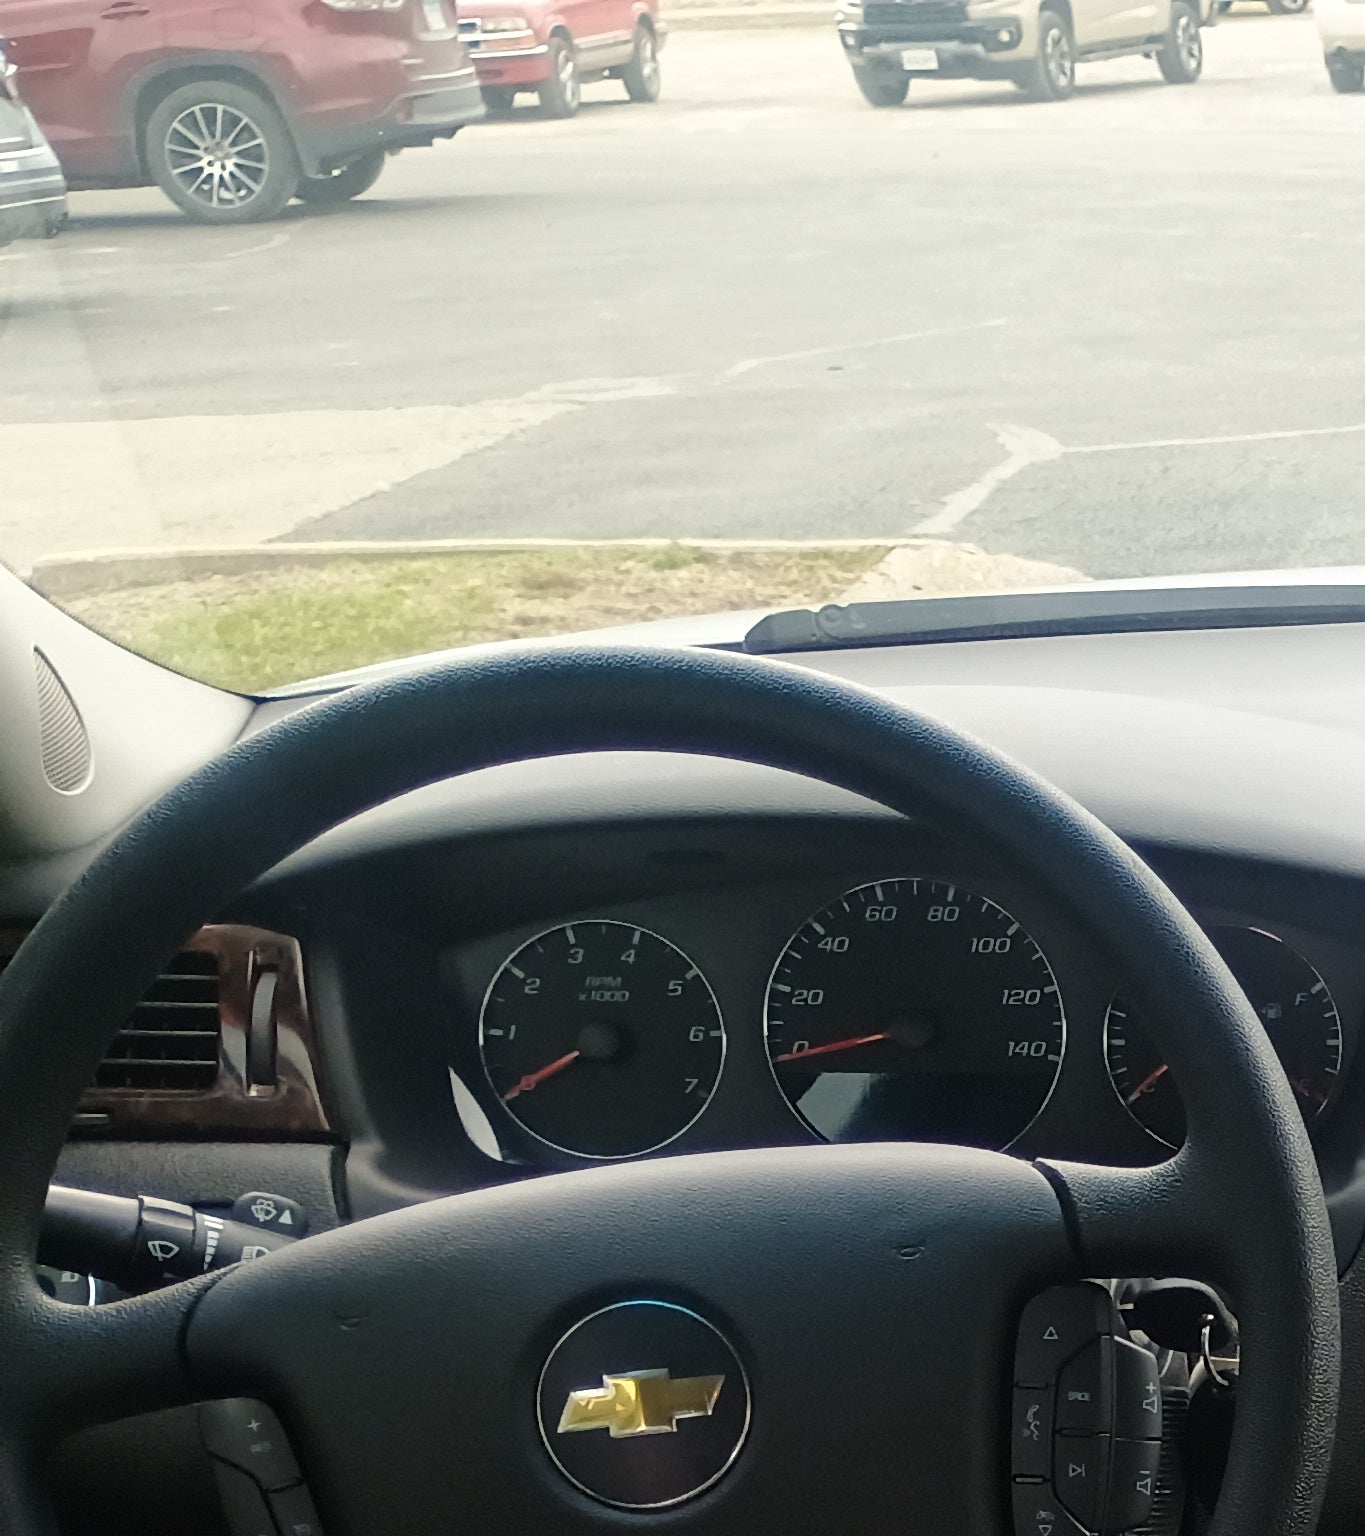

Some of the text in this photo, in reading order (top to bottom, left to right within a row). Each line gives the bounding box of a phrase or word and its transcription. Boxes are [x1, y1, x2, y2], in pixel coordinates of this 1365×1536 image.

[865, 906, 897, 922] 60
[927, 906, 960, 922] 80
[817, 936, 849, 953] 40
[970, 937, 1011, 954] 100
[567, 948, 584, 964] 3
[620, 949, 636, 964] 4
[524, 977, 541, 994] 2
[667, 980, 683, 996] 5
[791, 989, 824, 1005] 20
[1002, 989, 1041, 1005] 120
[509, 1024, 516, 1040] 1
[688, 1026, 704, 1042] 6
[1008, 1041, 1047, 1057] 140
[684, 1078, 698, 1094] 7
